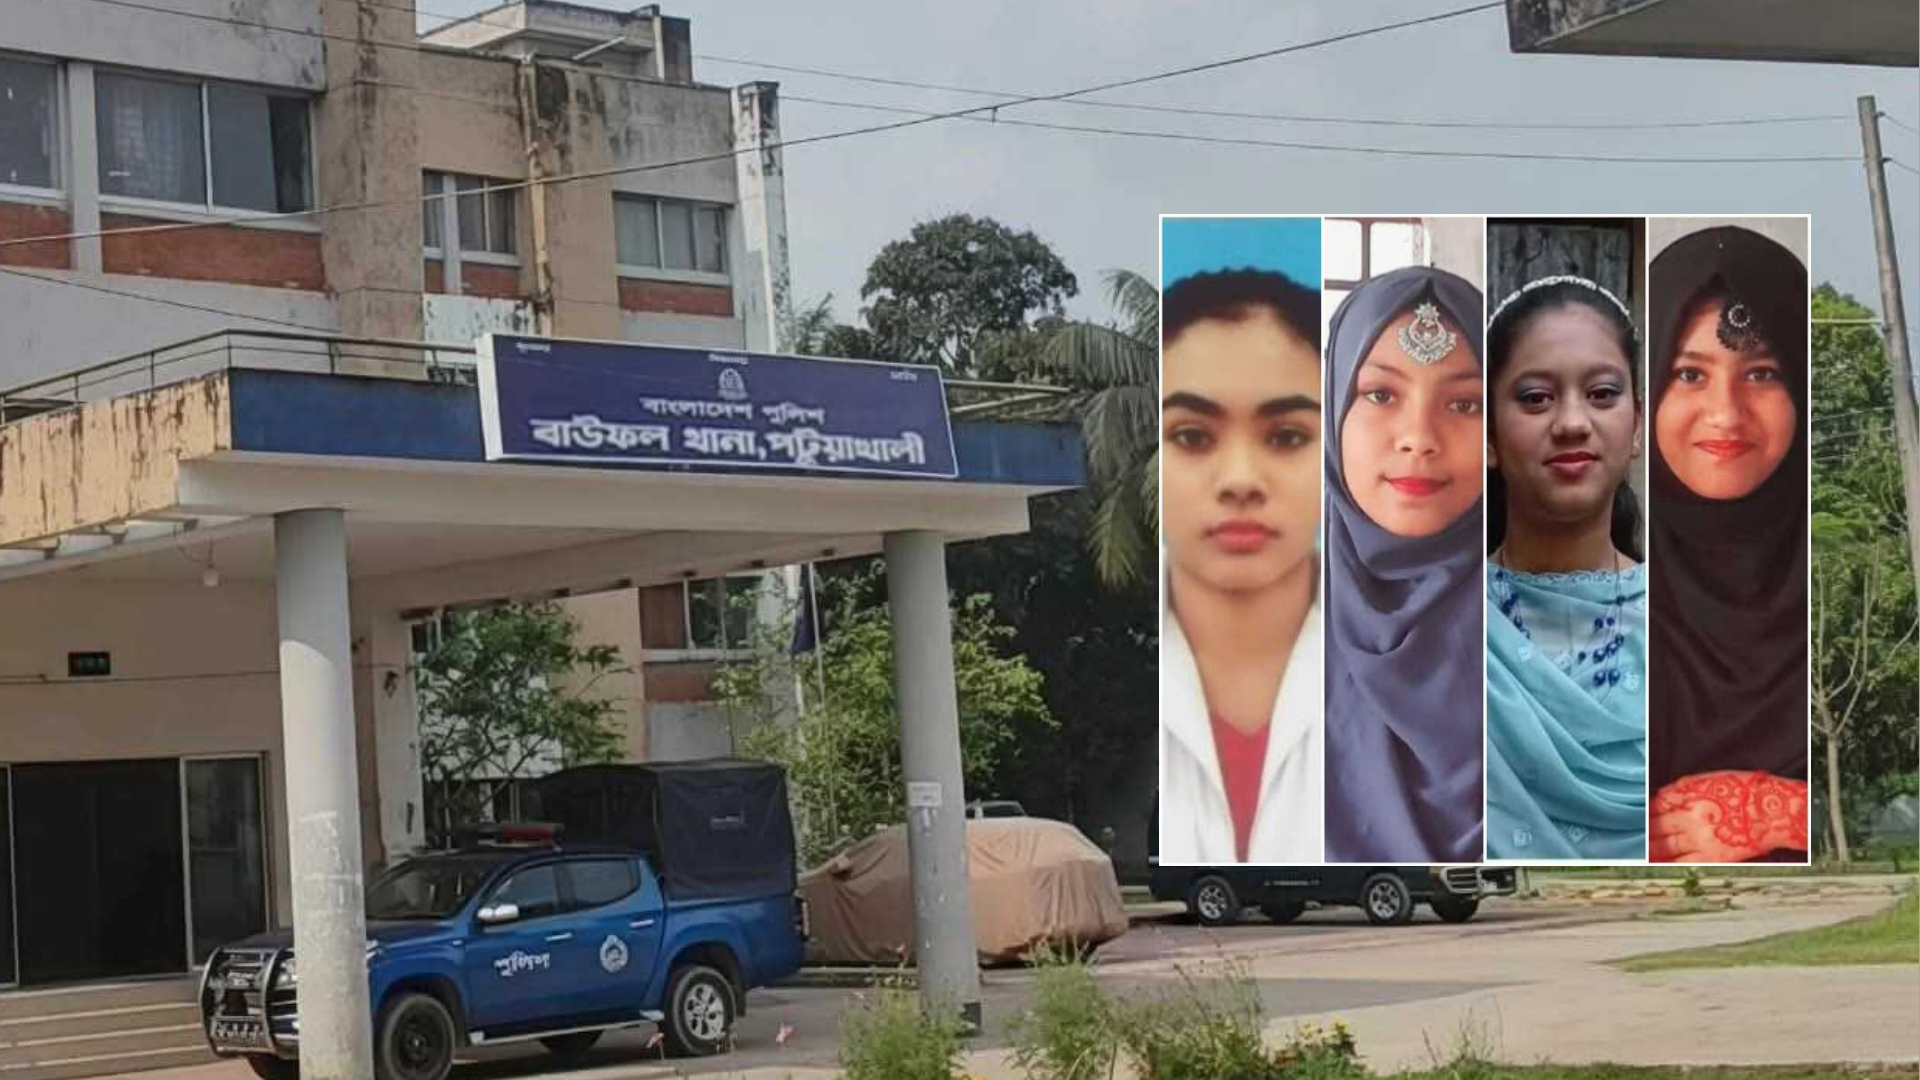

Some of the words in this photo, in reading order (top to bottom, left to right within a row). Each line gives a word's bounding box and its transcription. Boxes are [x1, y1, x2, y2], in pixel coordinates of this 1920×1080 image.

[639, 396, 752, 421] বাংলাদেশ
[761, 401, 826, 426] পুলিশ
[531, 415, 670, 451] বাউফল
